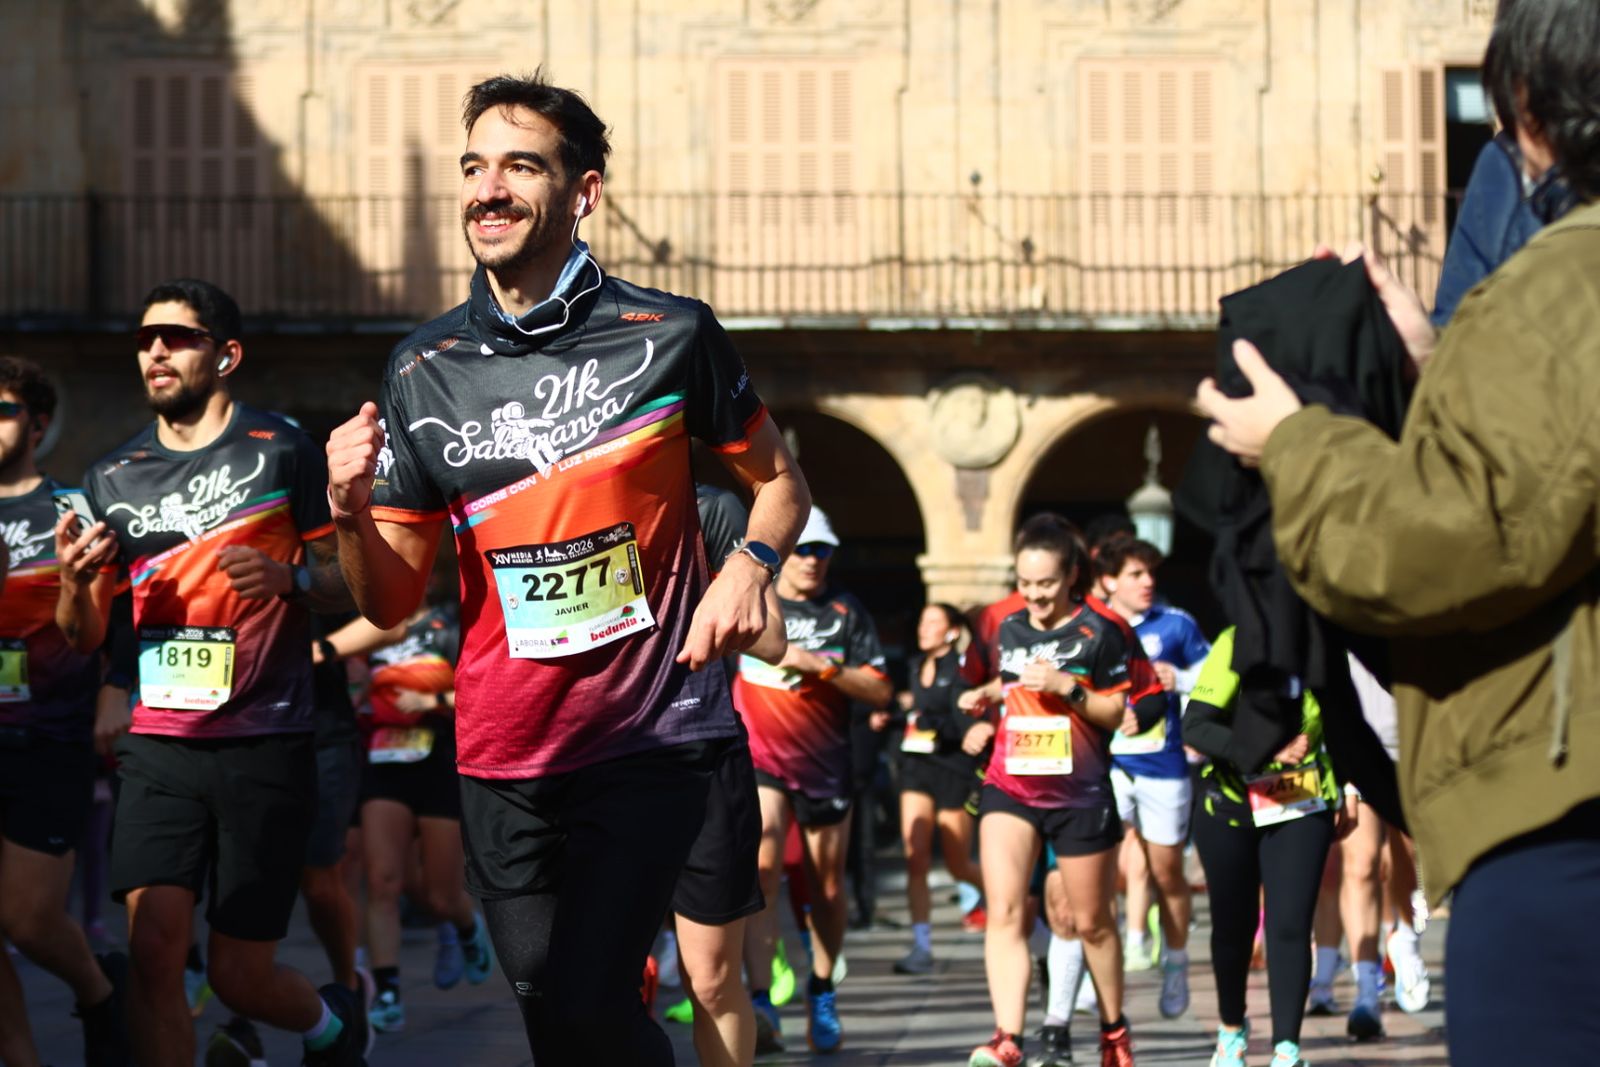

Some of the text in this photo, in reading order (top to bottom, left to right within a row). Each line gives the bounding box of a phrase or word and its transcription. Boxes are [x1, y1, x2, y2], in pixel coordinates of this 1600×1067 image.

[409, 391, 634, 467] Salamanca
[470, 438, 631, 512] CORRE CON LUZ PROPIA
[566, 538, 594, 556] 2026
[493, 553, 511, 565] XIV
[521, 556, 611, 601] 2277
[554, 602, 590, 617] JAVIER
[155, 646, 212, 668] 1819
[1014, 733, 1055, 748] 2577
